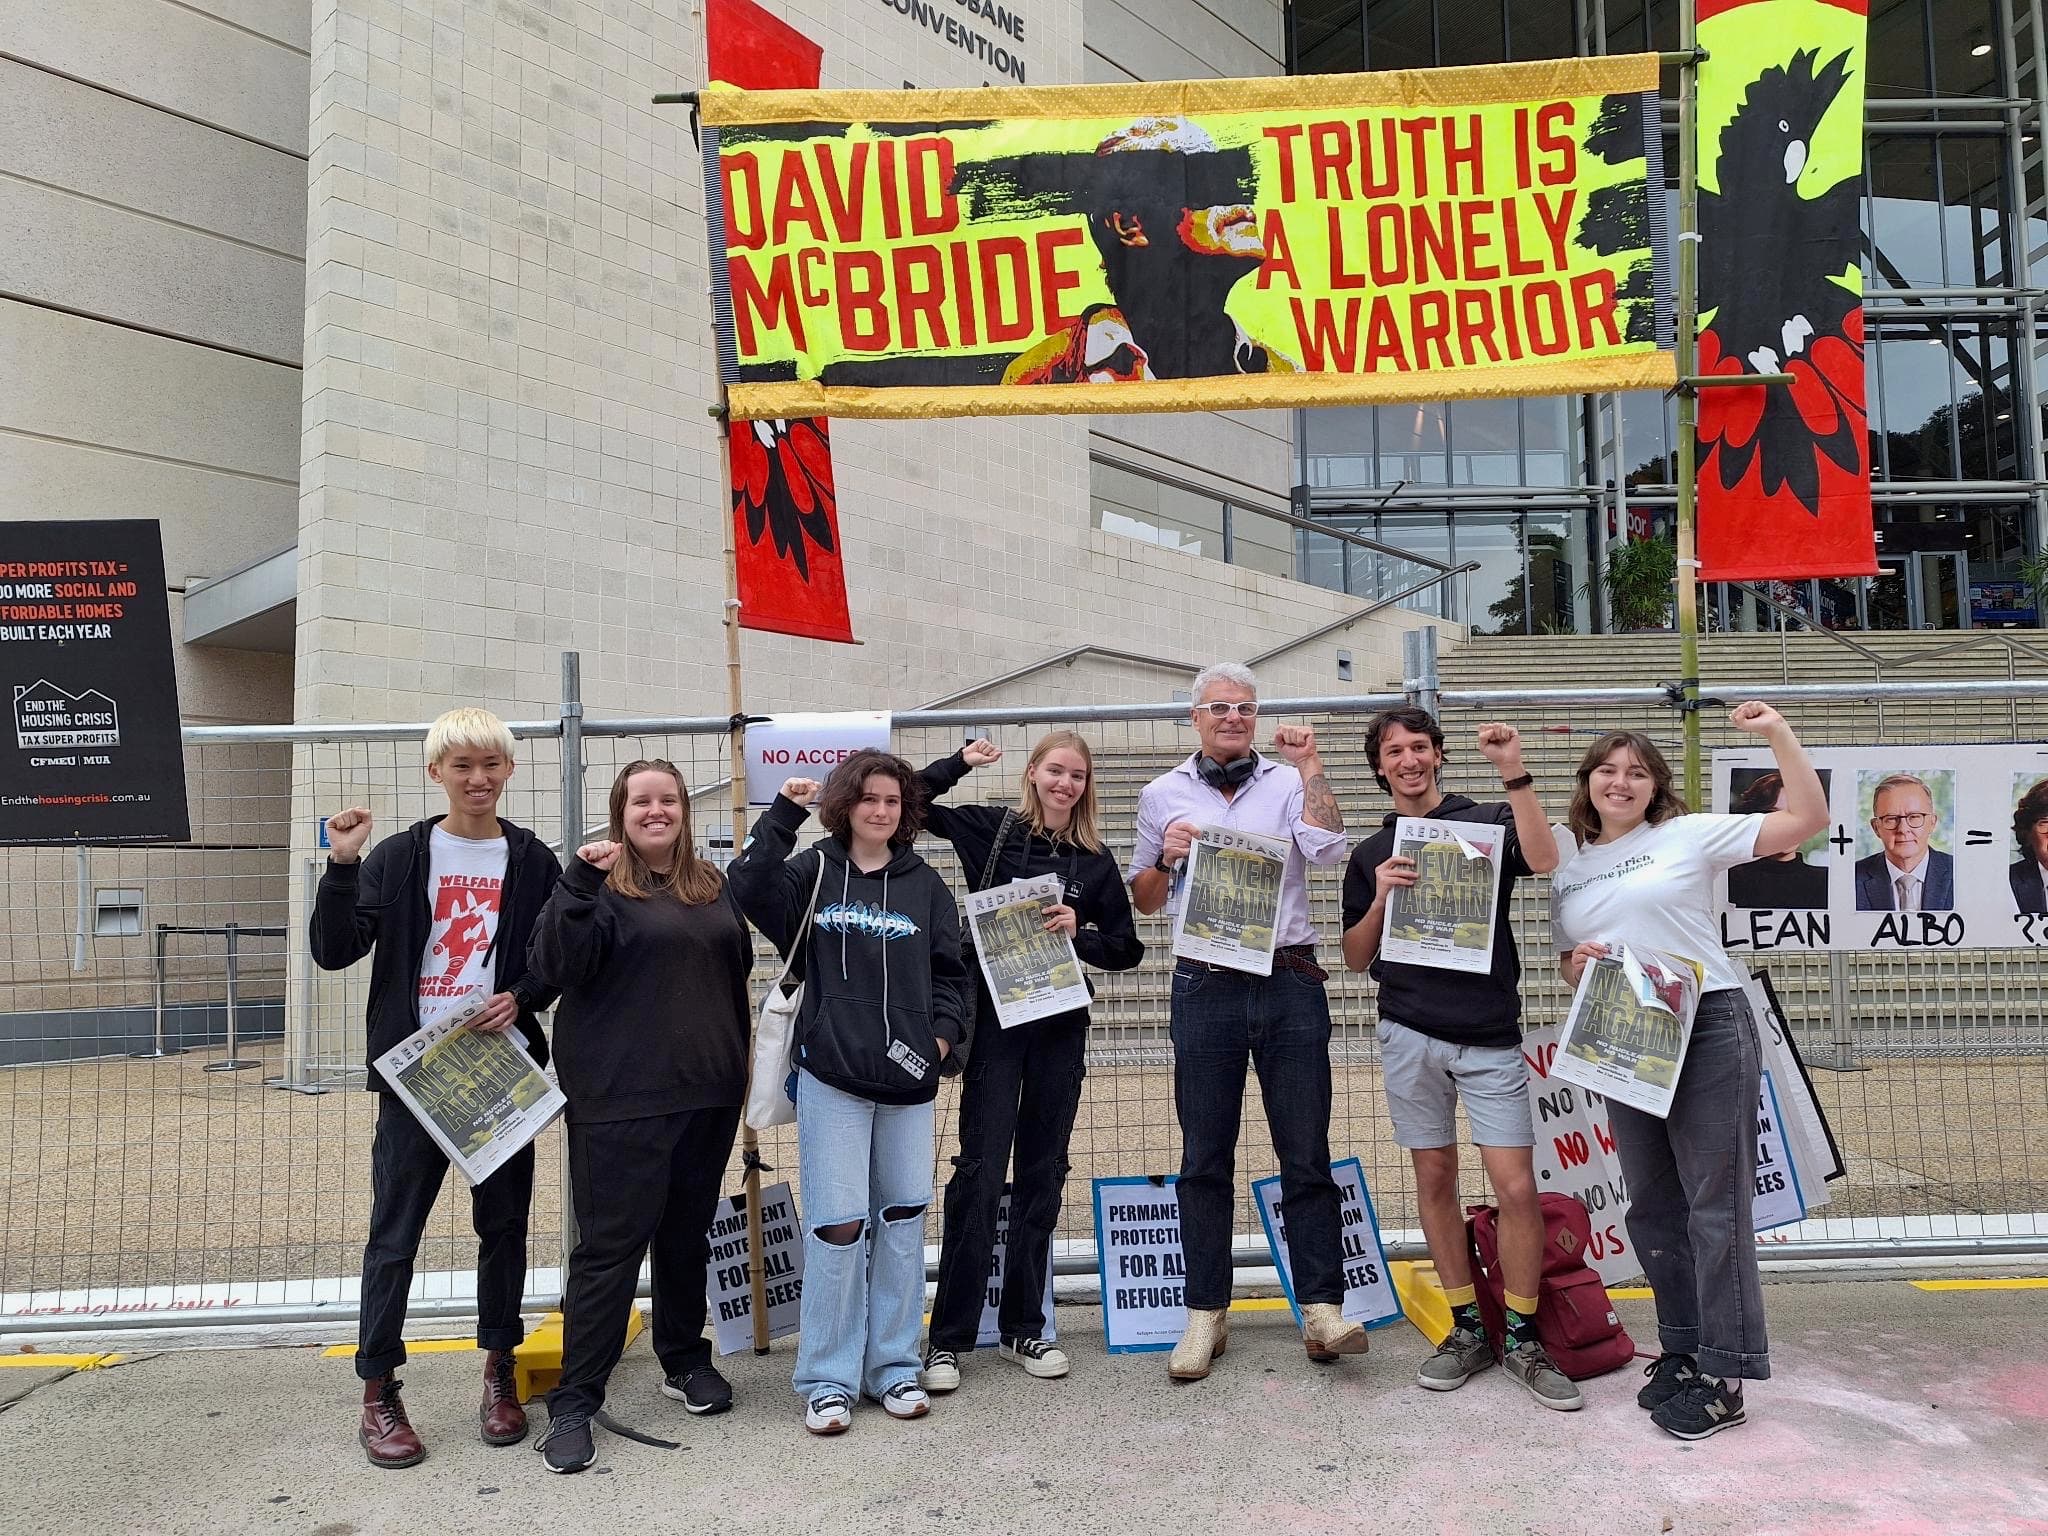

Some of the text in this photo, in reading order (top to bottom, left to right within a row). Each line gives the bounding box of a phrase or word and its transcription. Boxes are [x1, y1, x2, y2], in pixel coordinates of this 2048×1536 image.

[954, 0, 1025, 43] BANE
[1263, 101, 1577, 203] TRUTH IS
[720, 136, 960, 251] DAVID
[1256, 188, 1578, 291] A LONELY
[1287, 268, 1624, 375] WARRIOR
[1611, 508, 1647, 536] Lbor
[28, 562, 87, 577] PROFITS
[89, 561, 116, 576] TAX
[15, 583, 53, 599] MORE
[55, 582, 104, 598] SOCIAL
[108, 581, 137, 597] AND
[0, 603, 124, 620] FORDABLE HOMES
[0, 624, 112, 641] BUILT EACH YEAR
[21, 712, 113, 727] HOUSING CRISIS
[25, 700, 66, 712] END THE
[21, 732, 117, 746] TAX SUPER PROFITS
[30, 754, 111, 767] CFMEU MUA
[762, 750, 790, 764] NO
[1198, 851, 1277, 891] NEVER
[1195, 880, 1274, 922] AGAIN
[1400, 883, 1488, 918] AGAIN
[1721, 911, 1830, 950] LEAN
[1871, 912, 1965, 947] ALBO
[1582, 999, 1680, 1055] AGAIN
[438, 1041, 527, 1133] AGAIN
[1538, 1088, 1574, 1122] NO
[1553, 1131, 1589, 1170] NO
[763, 1251, 795, 1279] ALL
[1120, 1254, 1158, 1278] FOR
[719, 1279, 803, 1321] REFGEES
